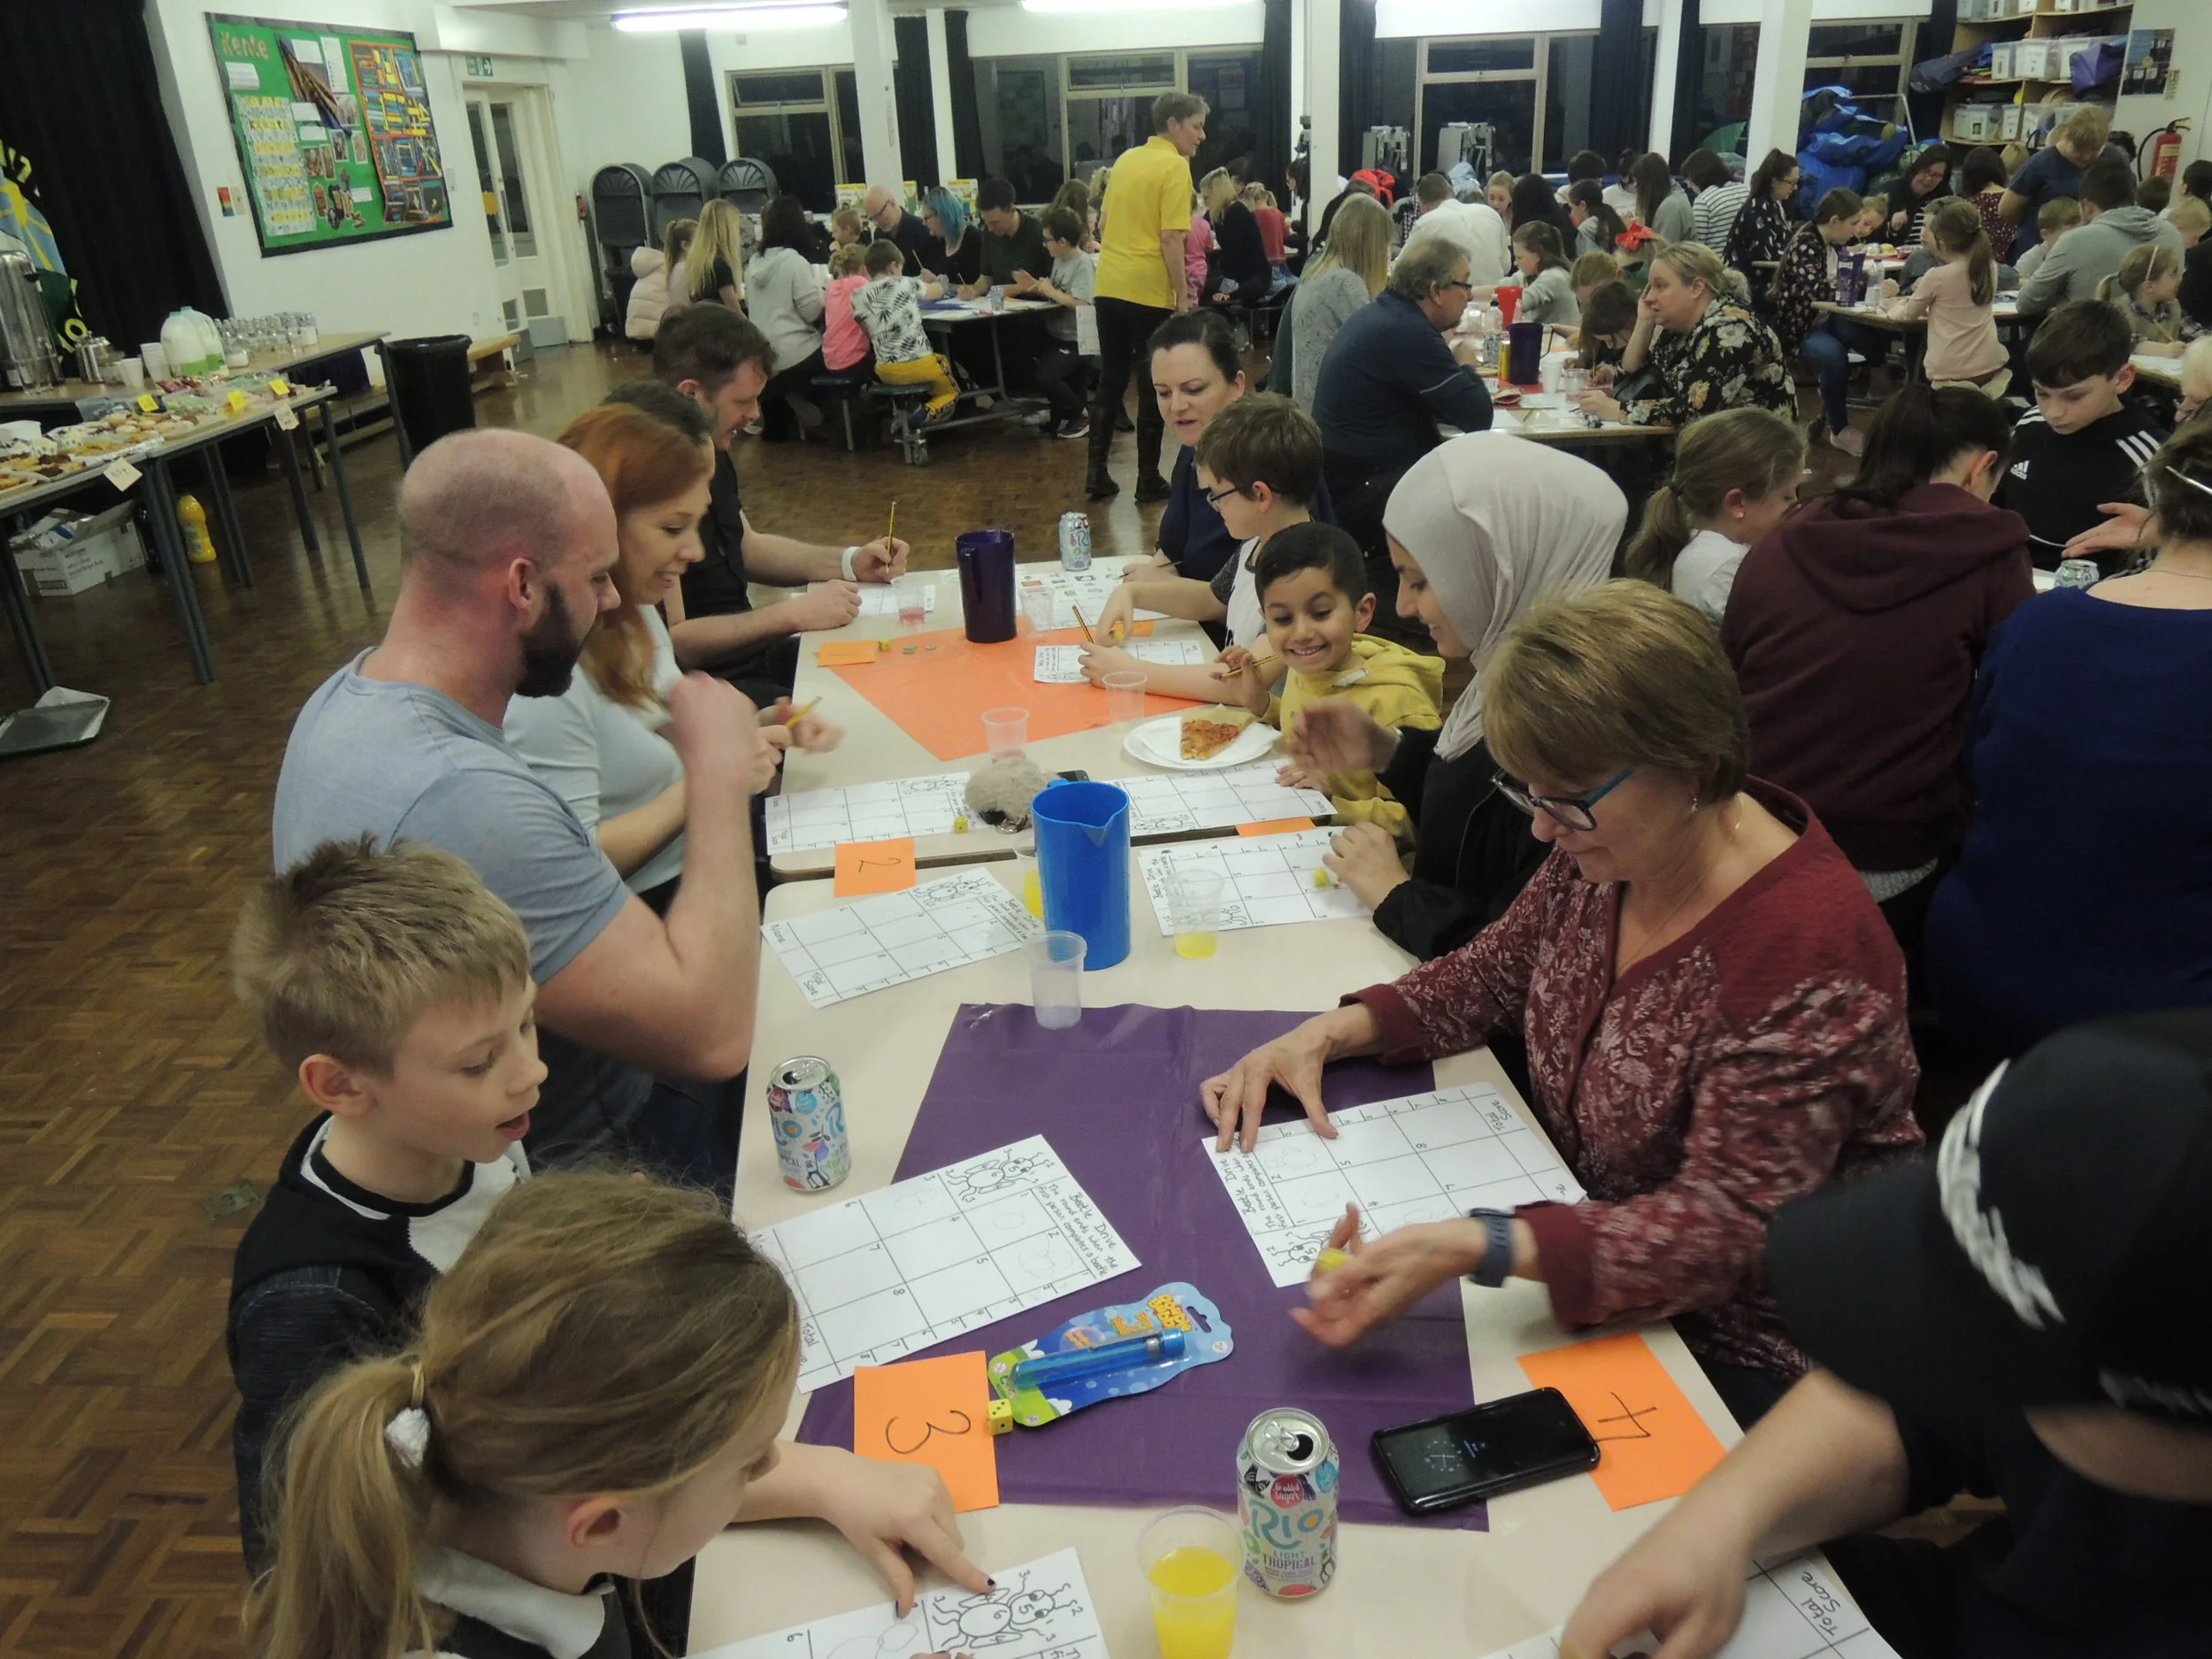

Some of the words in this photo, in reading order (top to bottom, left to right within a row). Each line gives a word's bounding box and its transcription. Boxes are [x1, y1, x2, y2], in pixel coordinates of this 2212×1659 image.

[859, 856, 902, 873] 2
[1486, 1111, 1507, 1131] Total
[1492, 1099, 1512, 1123] Score
[1219, 1159, 1237, 1183] Drive
[1236, 1188, 1256, 1216] Beetle
[1047, 1183, 1060, 1195] The
[1074, 1217, 1088, 1233] ends
[1105, 1256, 1118, 1269] the
[1069, 1191, 1092, 1219] Beetle
[1094, 1221, 1117, 1249] Drive
[802, 1322, 820, 1348] Total
[1596, 1391, 1657, 1443] 4
[886, 1409, 972, 1454] 3
[1264, 1553, 1316, 1570] TROPICAL
[1273, 1549, 1307, 1558] LIGHT
[1801, 1571, 1840, 1613] Score
[994, 1609, 1008, 1620] 6
[1018, 1603, 1034, 1615] 5
[1071, 1607, 1083, 1617] 2
[1800, 1598, 1838, 1637] Total
